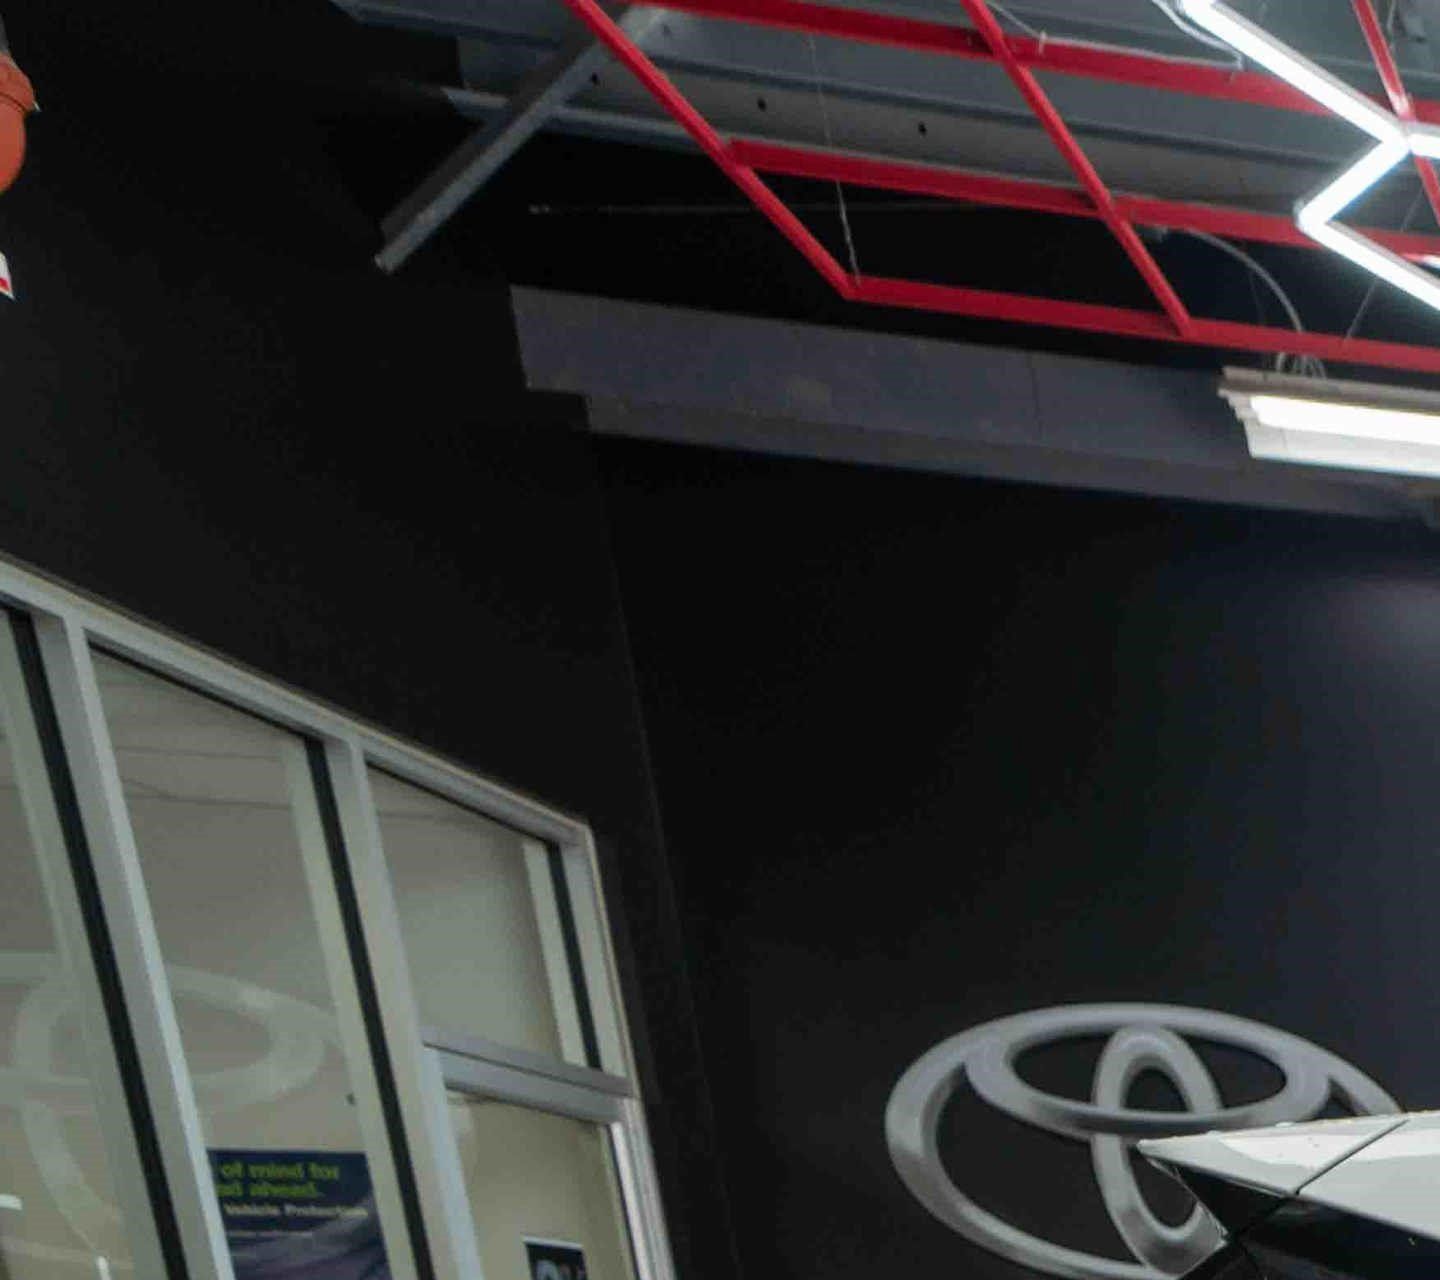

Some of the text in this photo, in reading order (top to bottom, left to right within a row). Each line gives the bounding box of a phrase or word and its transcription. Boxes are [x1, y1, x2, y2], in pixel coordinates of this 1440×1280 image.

[220, 1161, 341, 1181] of mind for
[224, 1203, 280, 1217] Vehicle
